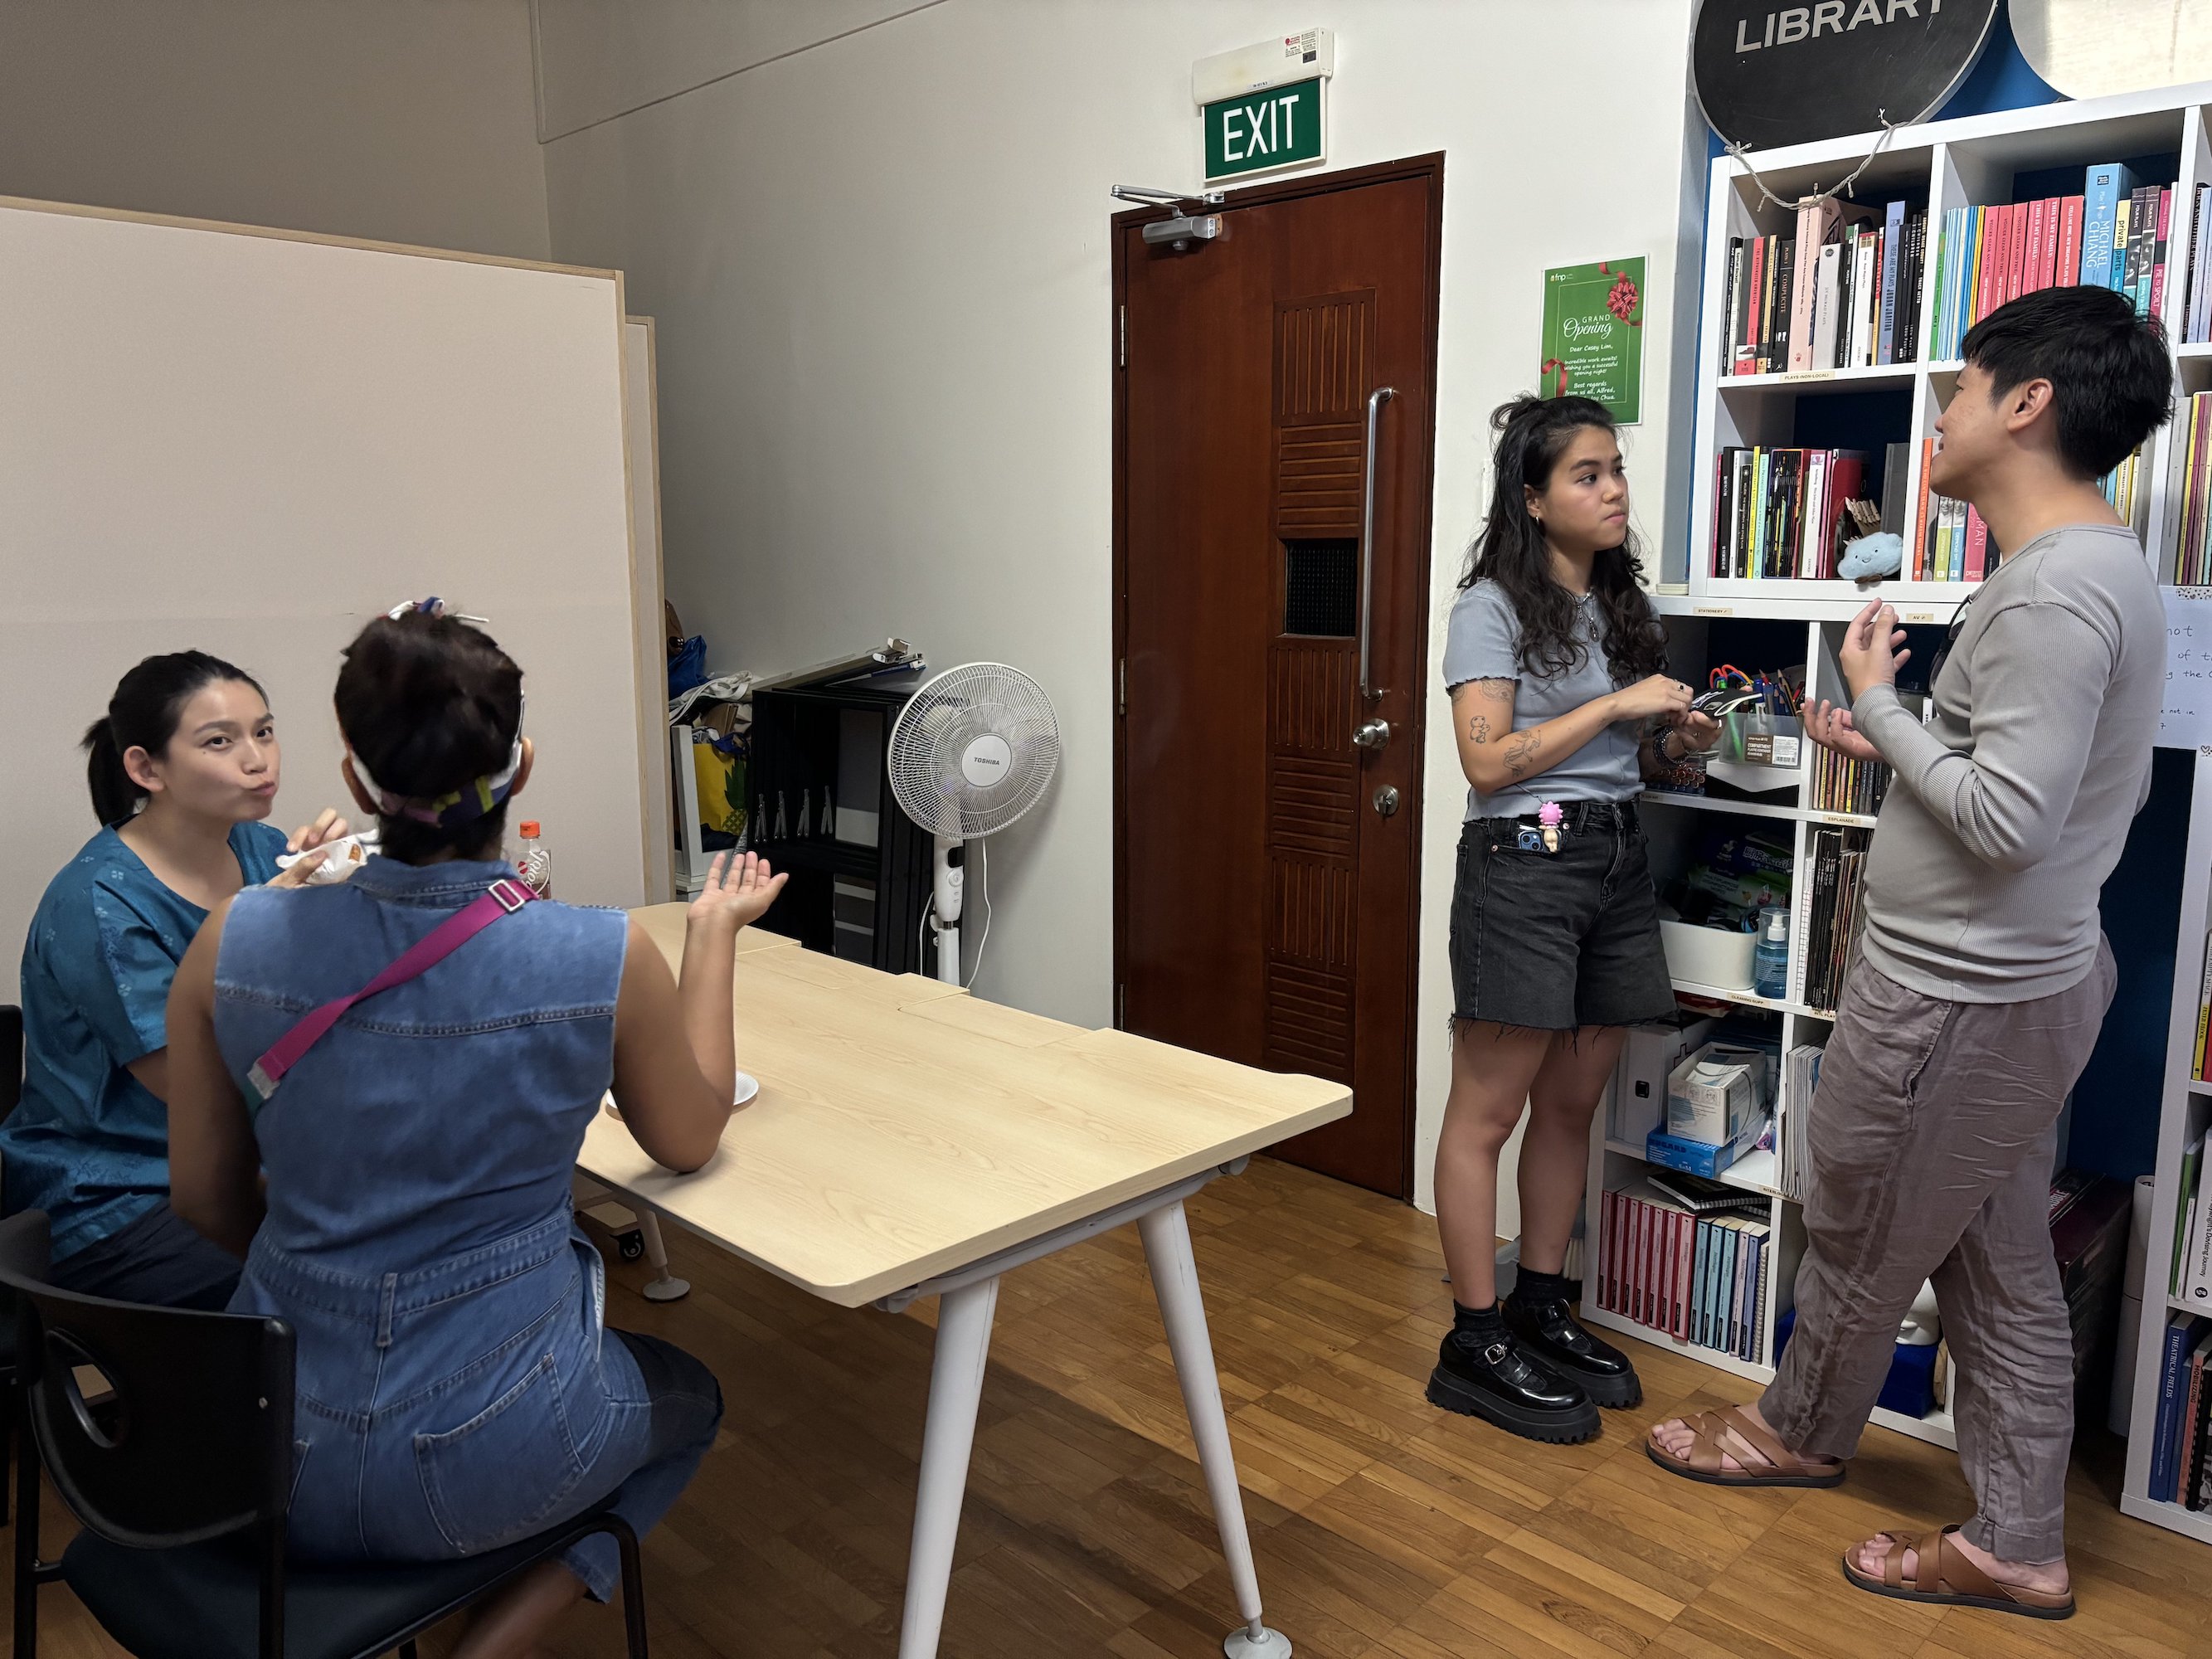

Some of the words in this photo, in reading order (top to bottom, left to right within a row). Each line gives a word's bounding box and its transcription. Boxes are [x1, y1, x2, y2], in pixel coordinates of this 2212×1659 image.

[1223, 95, 1299, 162] EXIT
[2035, 226, 2039, 236] MY
[2049, 224, 2055, 234] MY
[2117, 220, 2126, 247] private
[2086, 221, 2100, 268] CHIANG
[2097, 221, 2110, 269] MICHAEL
[2114, 251, 2123, 271] parts
[1563, 317, 1613, 342] Opening
[1582, 314, 1611, 324] GRAND
[2178, 649, 2191, 661] of
[2183, 670, 2203, 679] the
[2202, 1233, 2212, 1256] Devising
[2200, 1256, 2209, 1277] Journey
[2168, 1335, 2180, 1374] THEATRICAL
[2166, 1375, 2174, 1399] FIELDS
[2190, 1365, 2200, 1404] MOBILIZING
